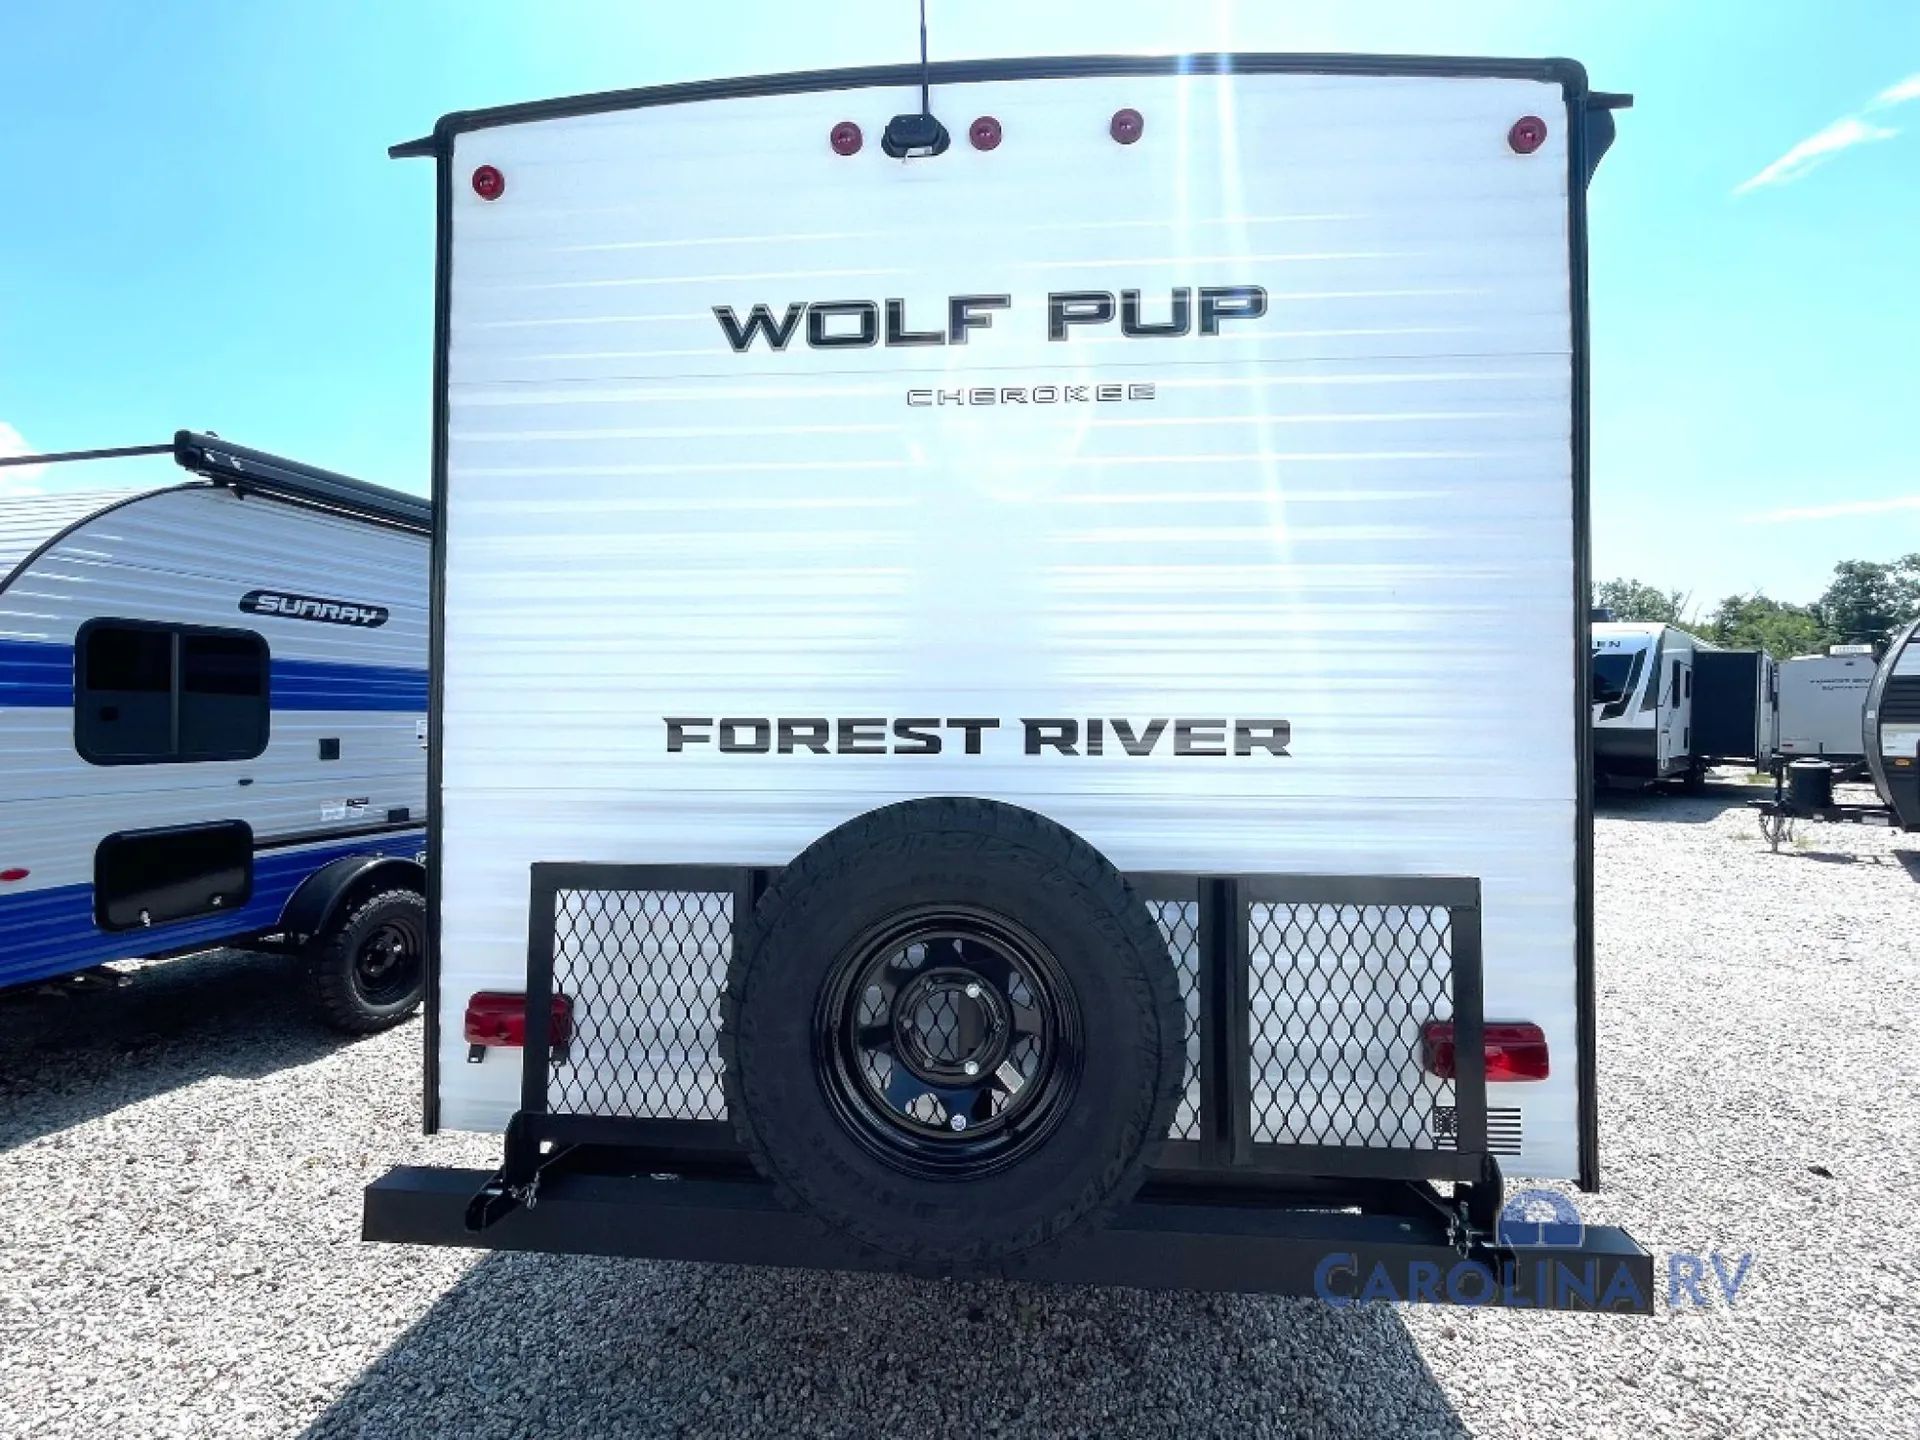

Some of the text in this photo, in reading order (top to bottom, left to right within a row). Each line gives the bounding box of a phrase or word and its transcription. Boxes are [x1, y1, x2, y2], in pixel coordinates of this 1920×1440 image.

[712, 285, 1268, 352] WOLF PUP
[906, 383, 1156, 406] CHEROKEE
[255, 595, 377, 623] SUNRAY
[662, 717, 1293, 758] FOREST RIVER
